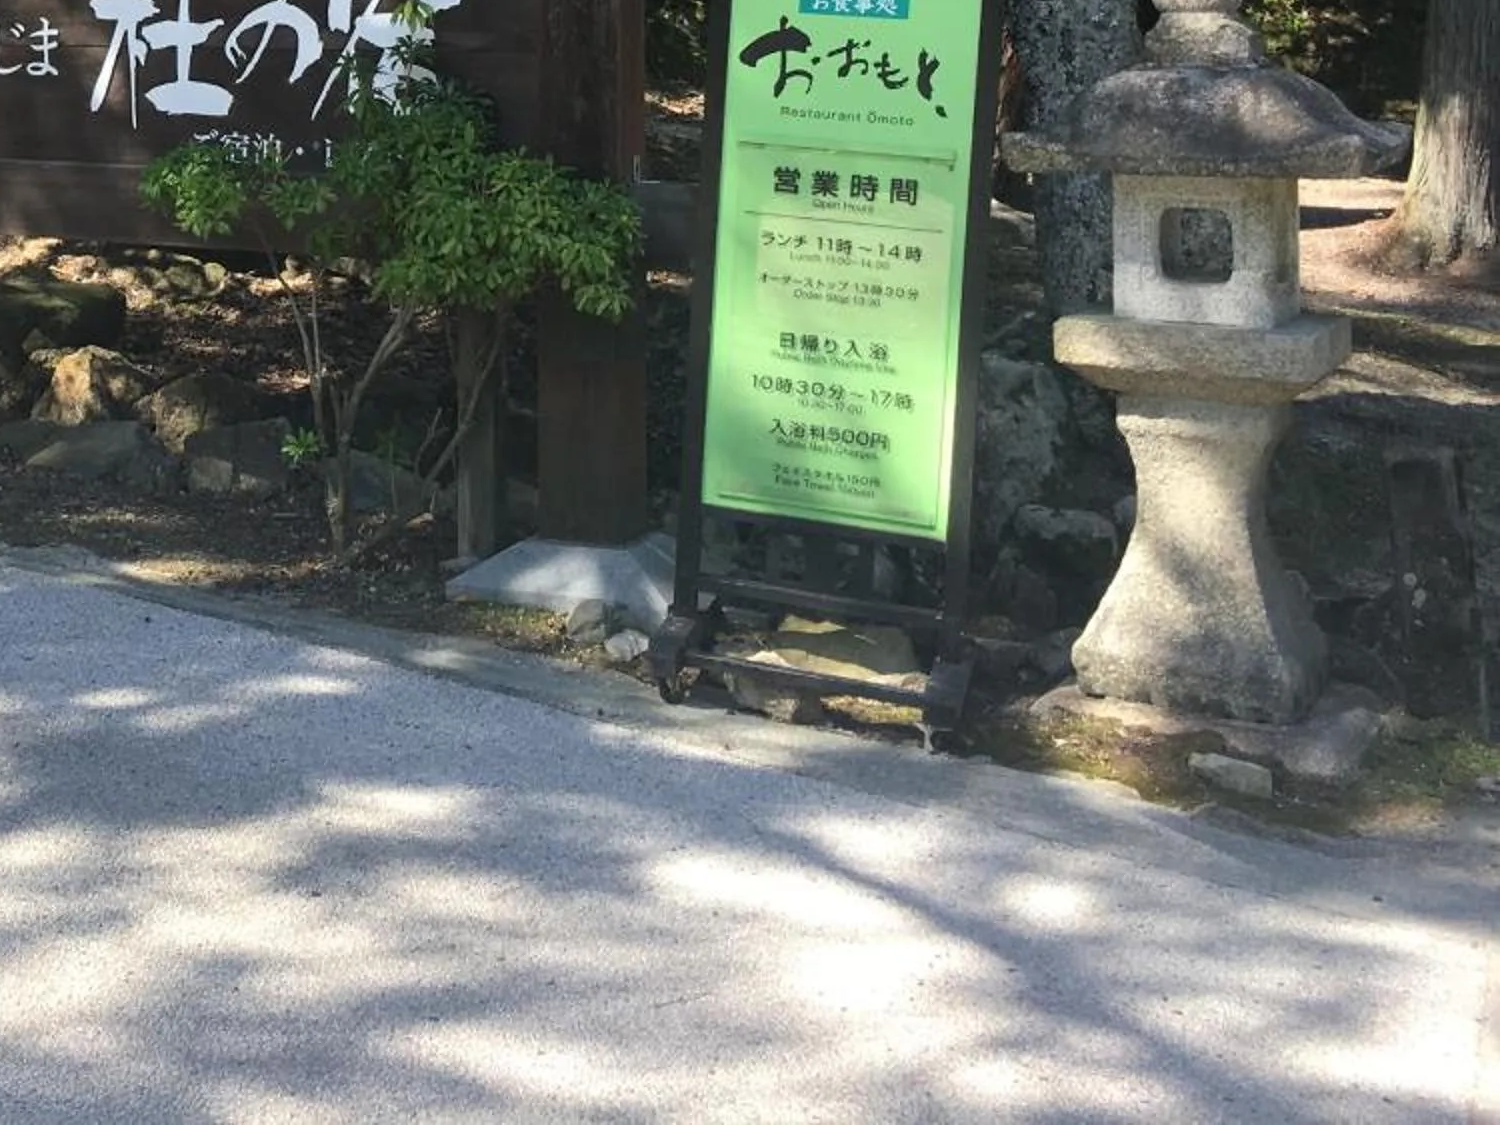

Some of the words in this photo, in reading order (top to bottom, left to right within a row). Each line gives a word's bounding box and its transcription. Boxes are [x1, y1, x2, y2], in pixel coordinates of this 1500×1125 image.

[780, 105, 861, 123] Restaurant
[773, 165, 919, 207] 営業時間
[760, 229, 807, 248] ランチ
[779, 331, 889, 362] 日帰り入浴
